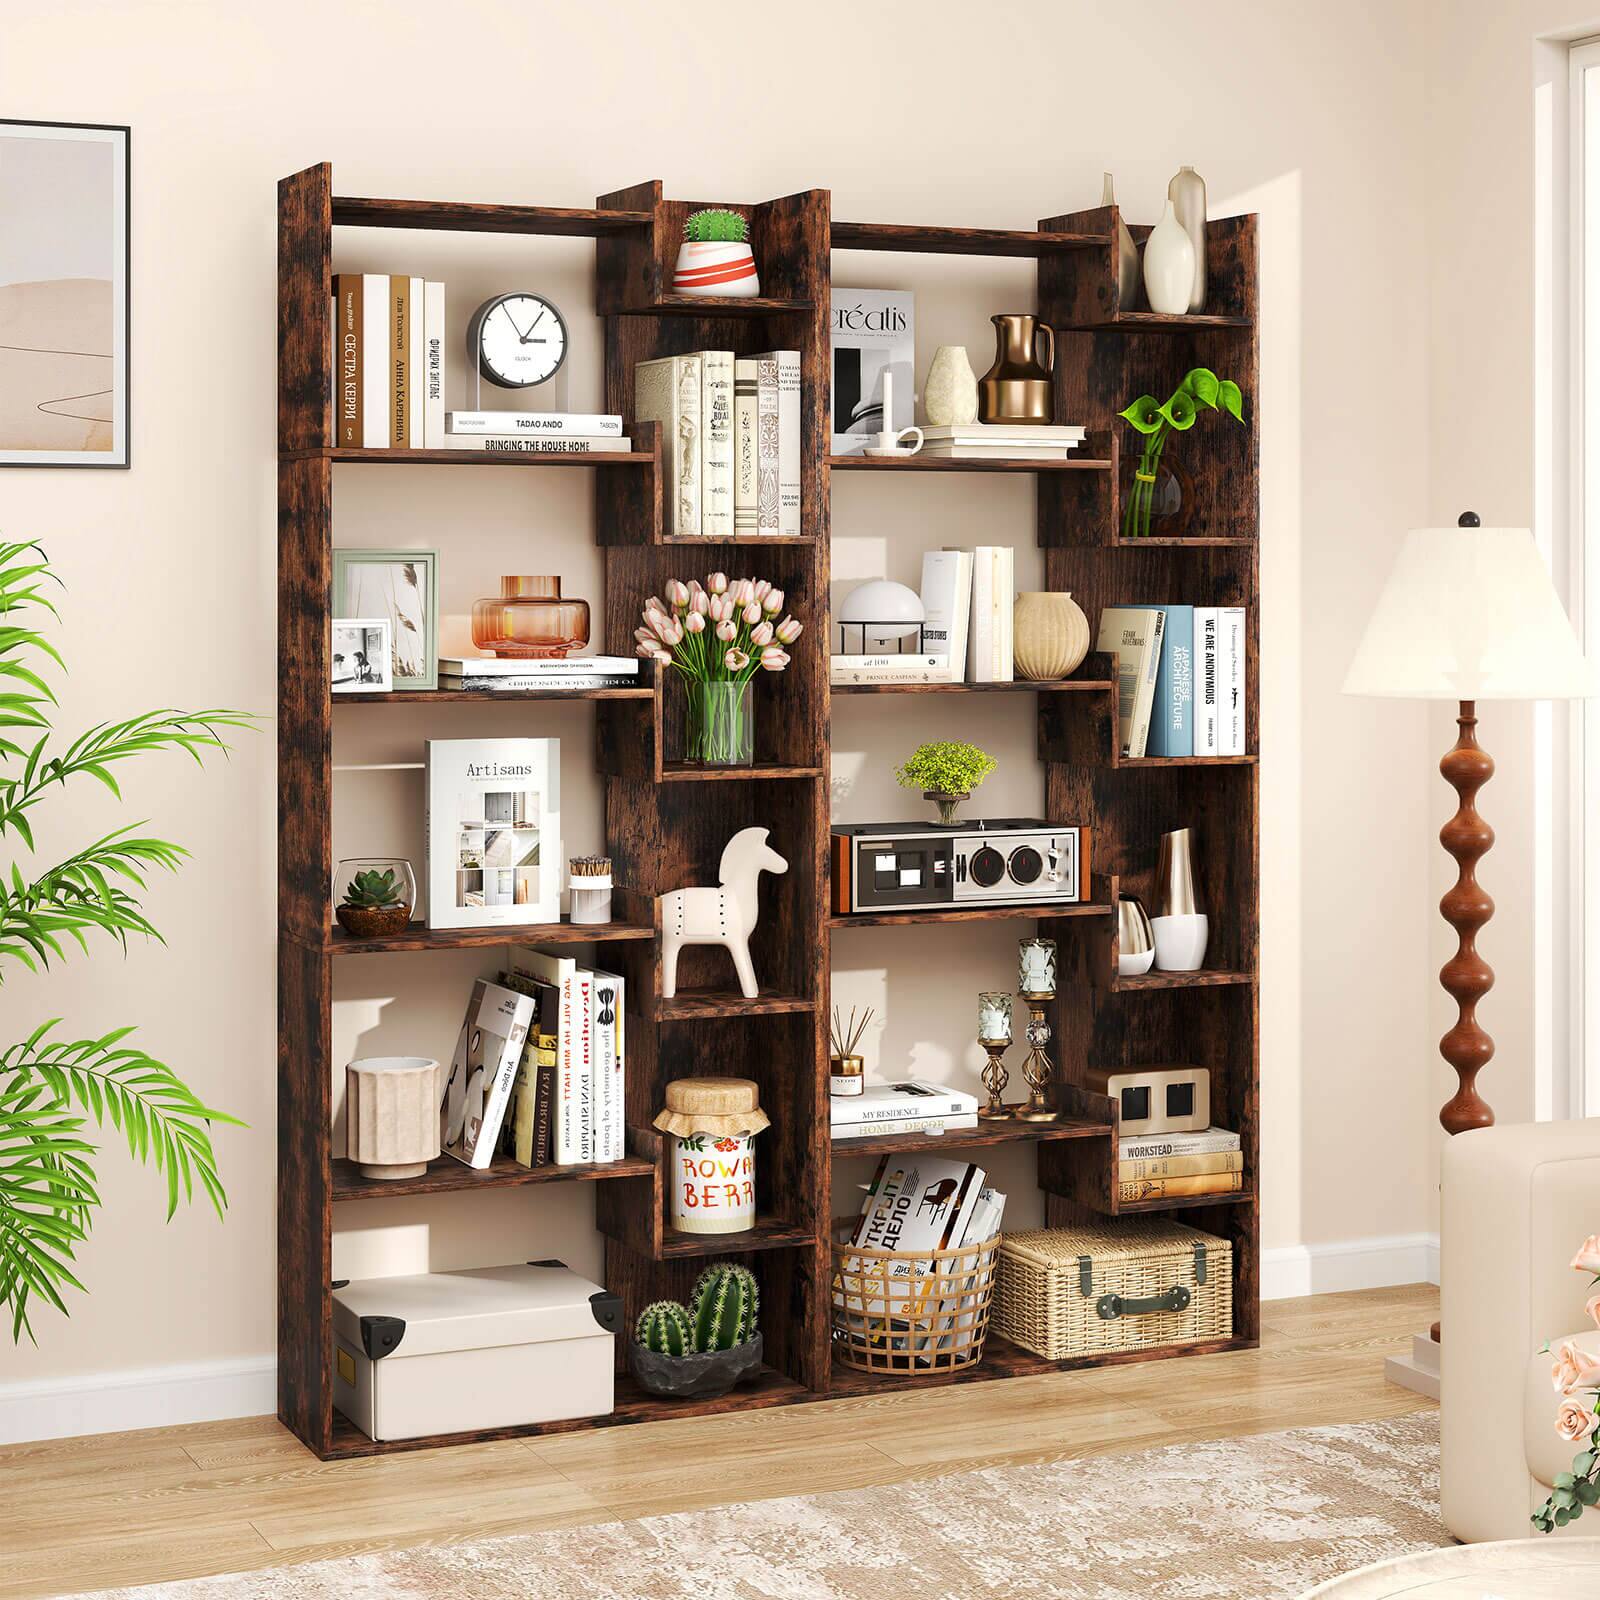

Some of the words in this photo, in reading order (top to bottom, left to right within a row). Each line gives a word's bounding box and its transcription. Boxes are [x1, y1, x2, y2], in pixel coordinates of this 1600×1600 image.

[345, 334, 356, 378] СЕСТРА
[430, 339, 440, 370] ФРИДРИХ
[430, 372, 440, 400] ЭНГЕЛЬС
[345, 382, 356, 419] КЕРРИ
[516, 419, 541, 429] TADAO
[542, 420, 563, 429] ANDO
[485, 440, 522, 451] BRINGING
[525, 440, 541, 451] THE
[542, 441, 567, 451] HOUSE
[568, 441, 590, 452] HOME
[1205, 619, 1215, 632] WE
[1205, 635, 1215, 651] ARE
[1182, 646, 1190, 701] JAPANESE
[1205, 653, 1215, 705] ANONYMOUS
[1173, 646, 1182, 730] ARCHITECTURE
[466, 763, 533, 777] Artisans
[862, 1110, 876, 1120] MY
[876, 1107, 921, 1119] RESIDENCE
[858, 1123, 896, 1136] HOME
[904, 1119, 945, 1131] DECOR
[1127, 1144, 1173, 1158] WORKSTEAD
[881, 1197, 911, 1251] ДЕЛО
[893, 1264, 925, 1277] ДИЗЙН
